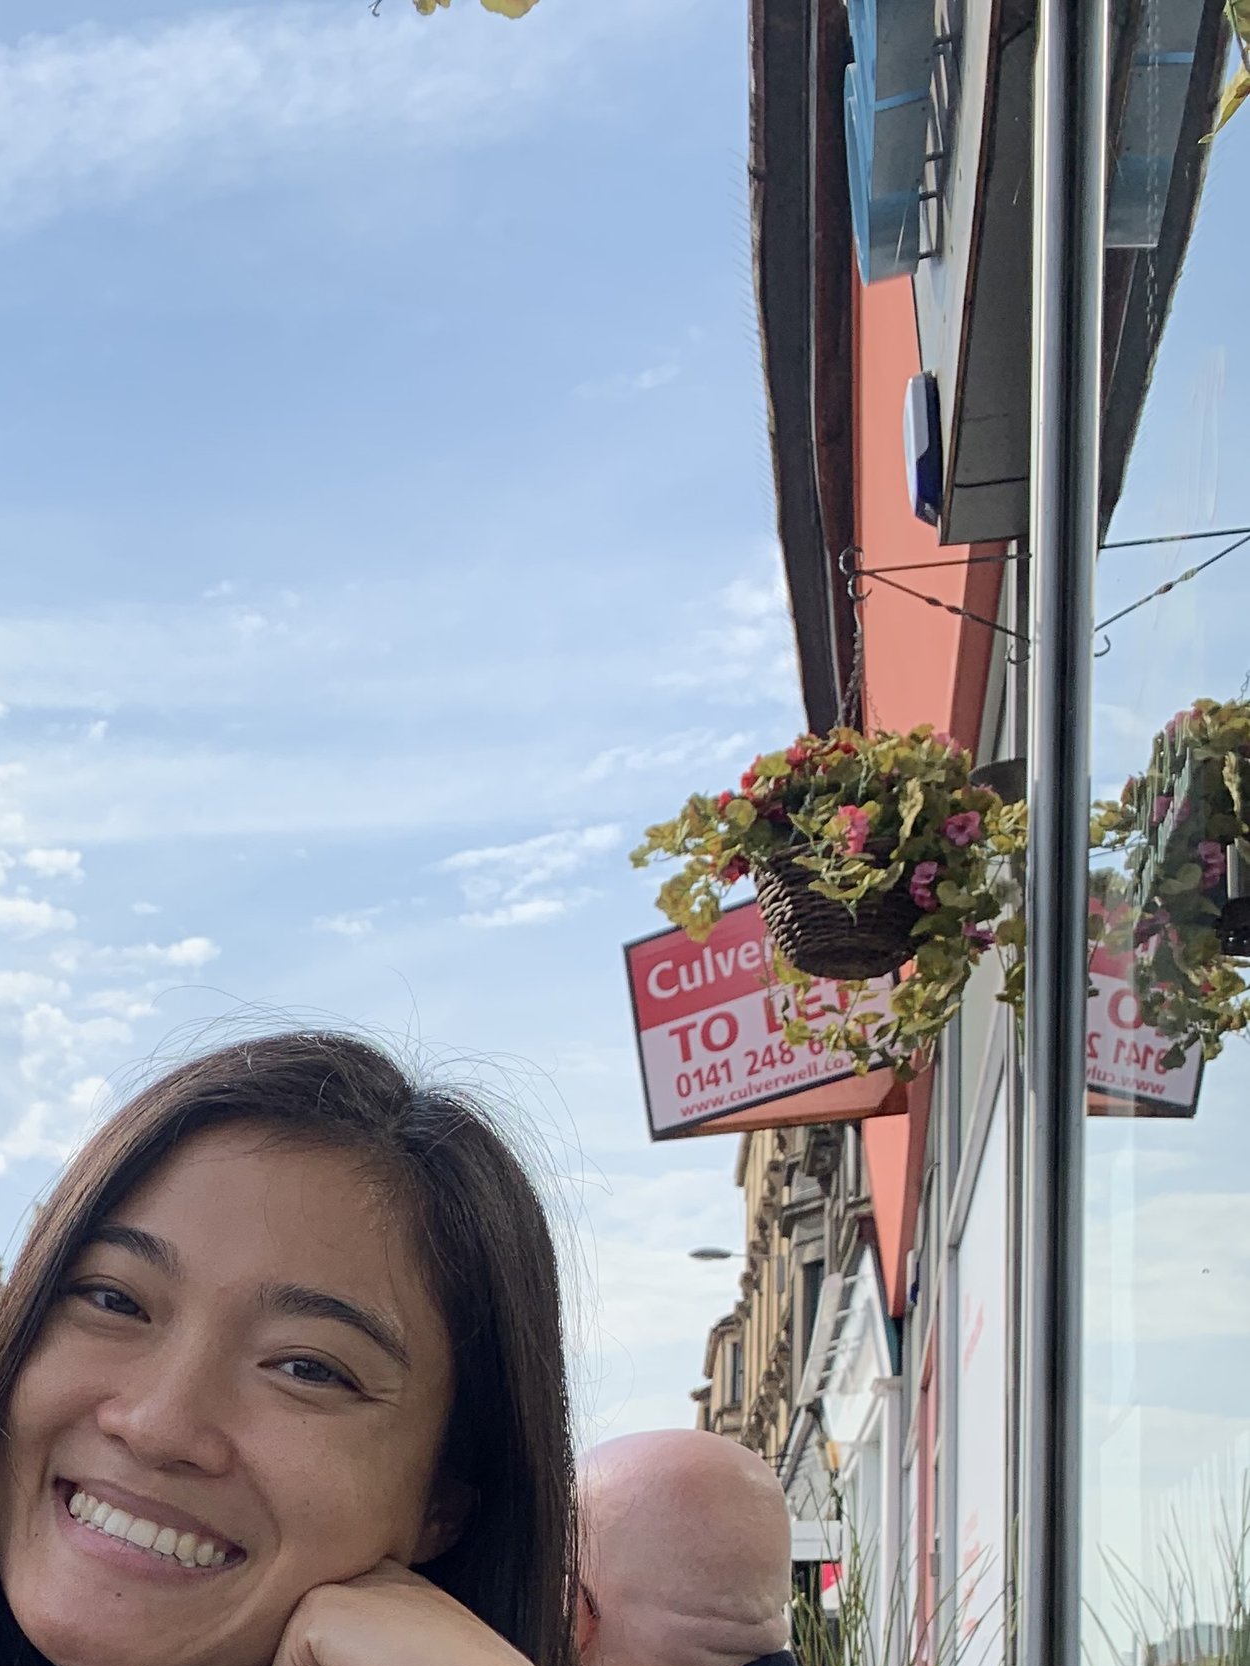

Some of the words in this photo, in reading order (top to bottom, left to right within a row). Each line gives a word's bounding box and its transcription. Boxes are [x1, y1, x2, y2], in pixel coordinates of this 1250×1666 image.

[647, 936, 775, 999] Culver
[668, 1011, 738, 1063] TO
[676, 1059, 732, 1098] 0141
[745, 1040, 795, 1076] 248
[680, 1057, 850, 1117] www.culverwell.co.
